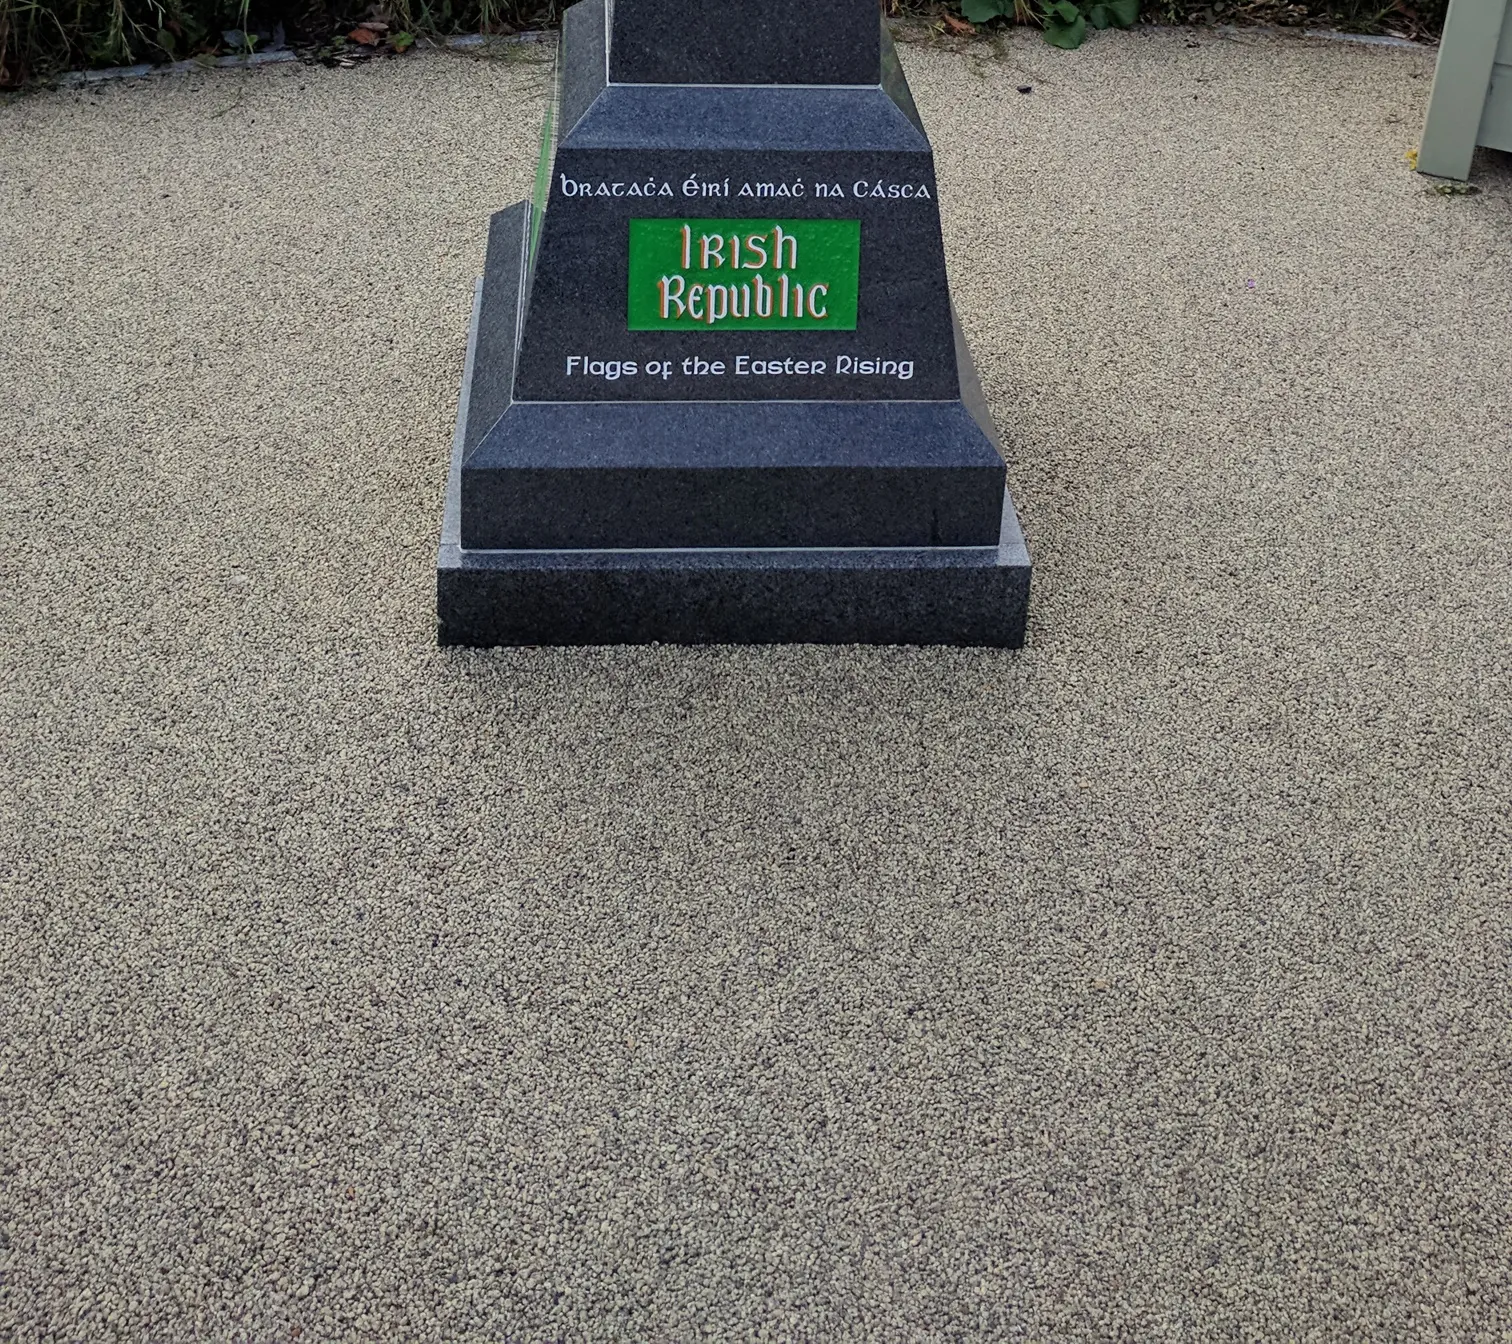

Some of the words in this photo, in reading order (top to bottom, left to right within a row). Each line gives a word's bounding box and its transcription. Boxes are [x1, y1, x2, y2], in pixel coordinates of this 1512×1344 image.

[680, 224, 798, 269] Irish
[656, 273, 829, 324] Republic
[566, 356, 638, 381] Flags
[645, 360, 673, 380] of
[681, 355, 726, 375] the
[735, 355, 827, 375] Easter
[835, 355, 914, 380] Rising
